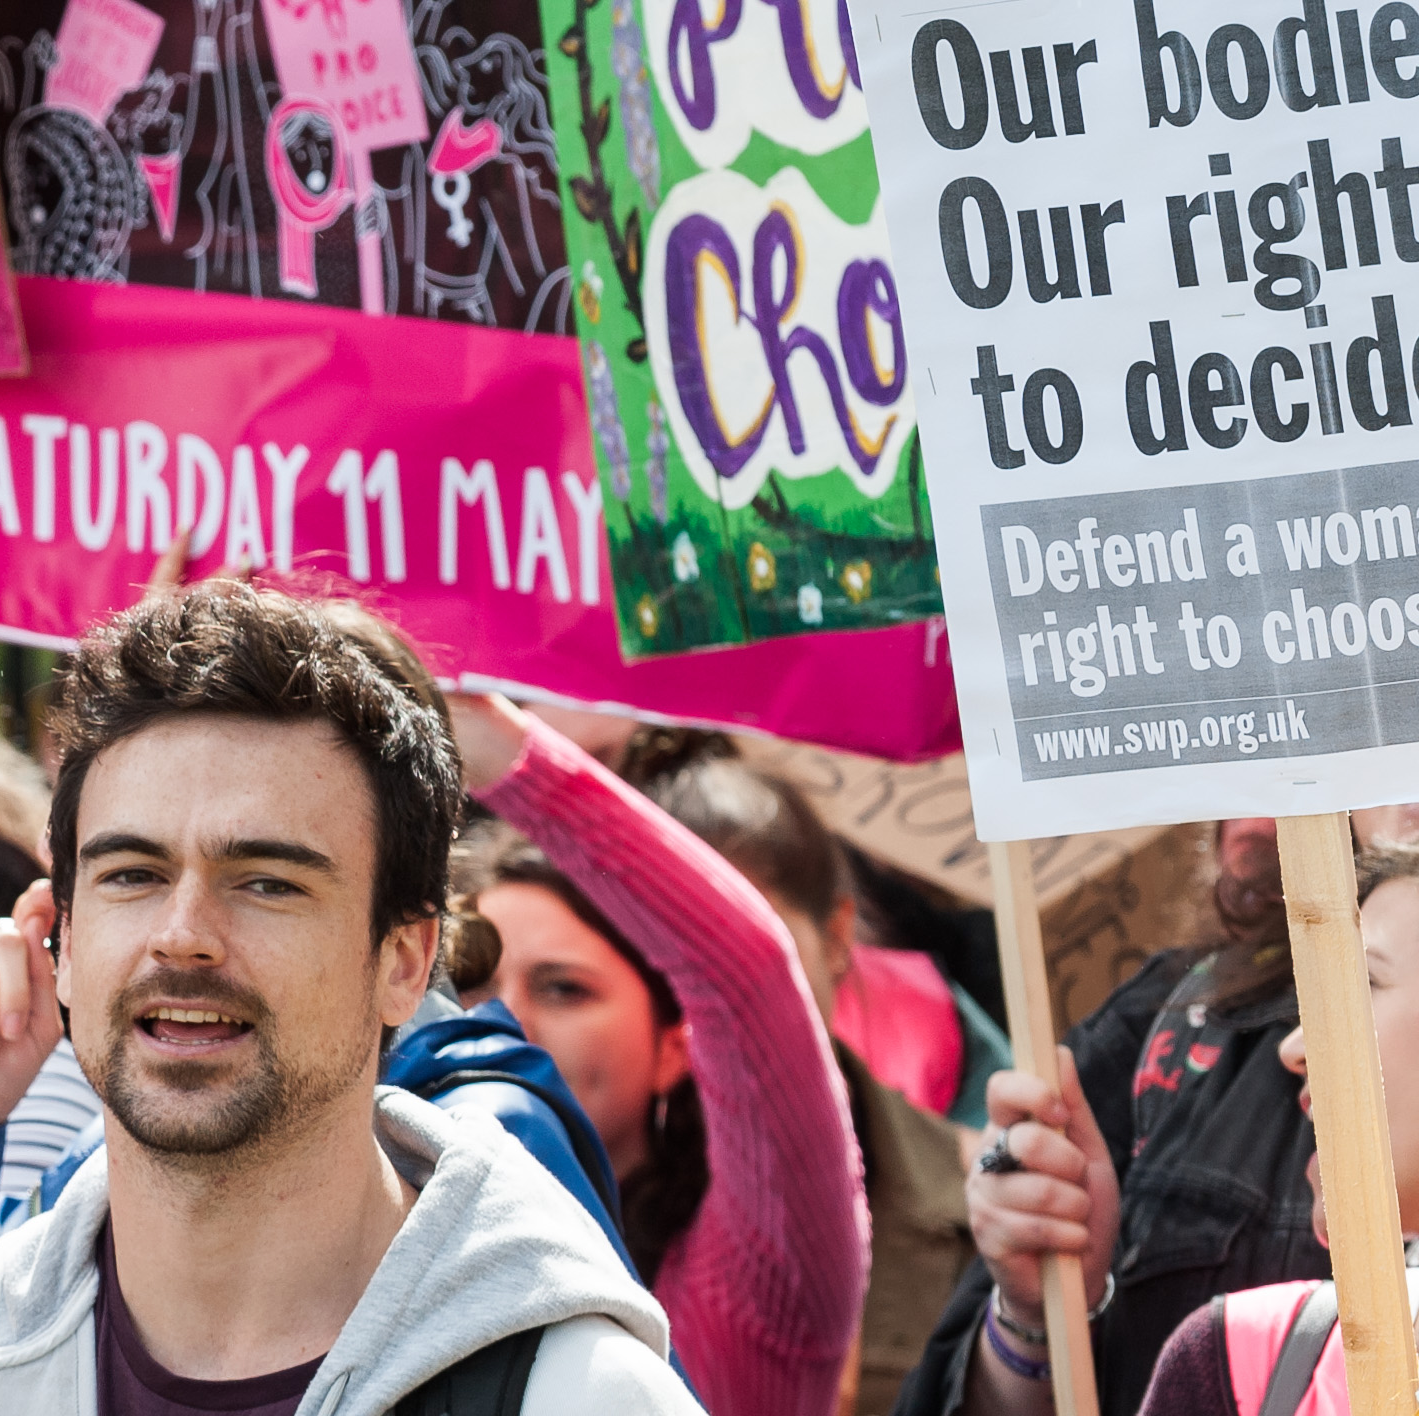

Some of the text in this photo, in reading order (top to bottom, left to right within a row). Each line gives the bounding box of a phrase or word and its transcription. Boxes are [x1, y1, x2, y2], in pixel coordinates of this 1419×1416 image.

[911, 0, 1419, 151] Our bodie
[938, 137, 1419, 312] Our right
[971, 294, 1419, 469] to decid
[326, 448, 406, 584] 11
[437, 456, 603, 607] MAY
[1000, 503, 1419, 598] Defend a wom
[1018, 605, 1165, 698] right
[1177, 601, 1243, 672] to
[1033, 700, 1311, 764] www.swp.org.uk
